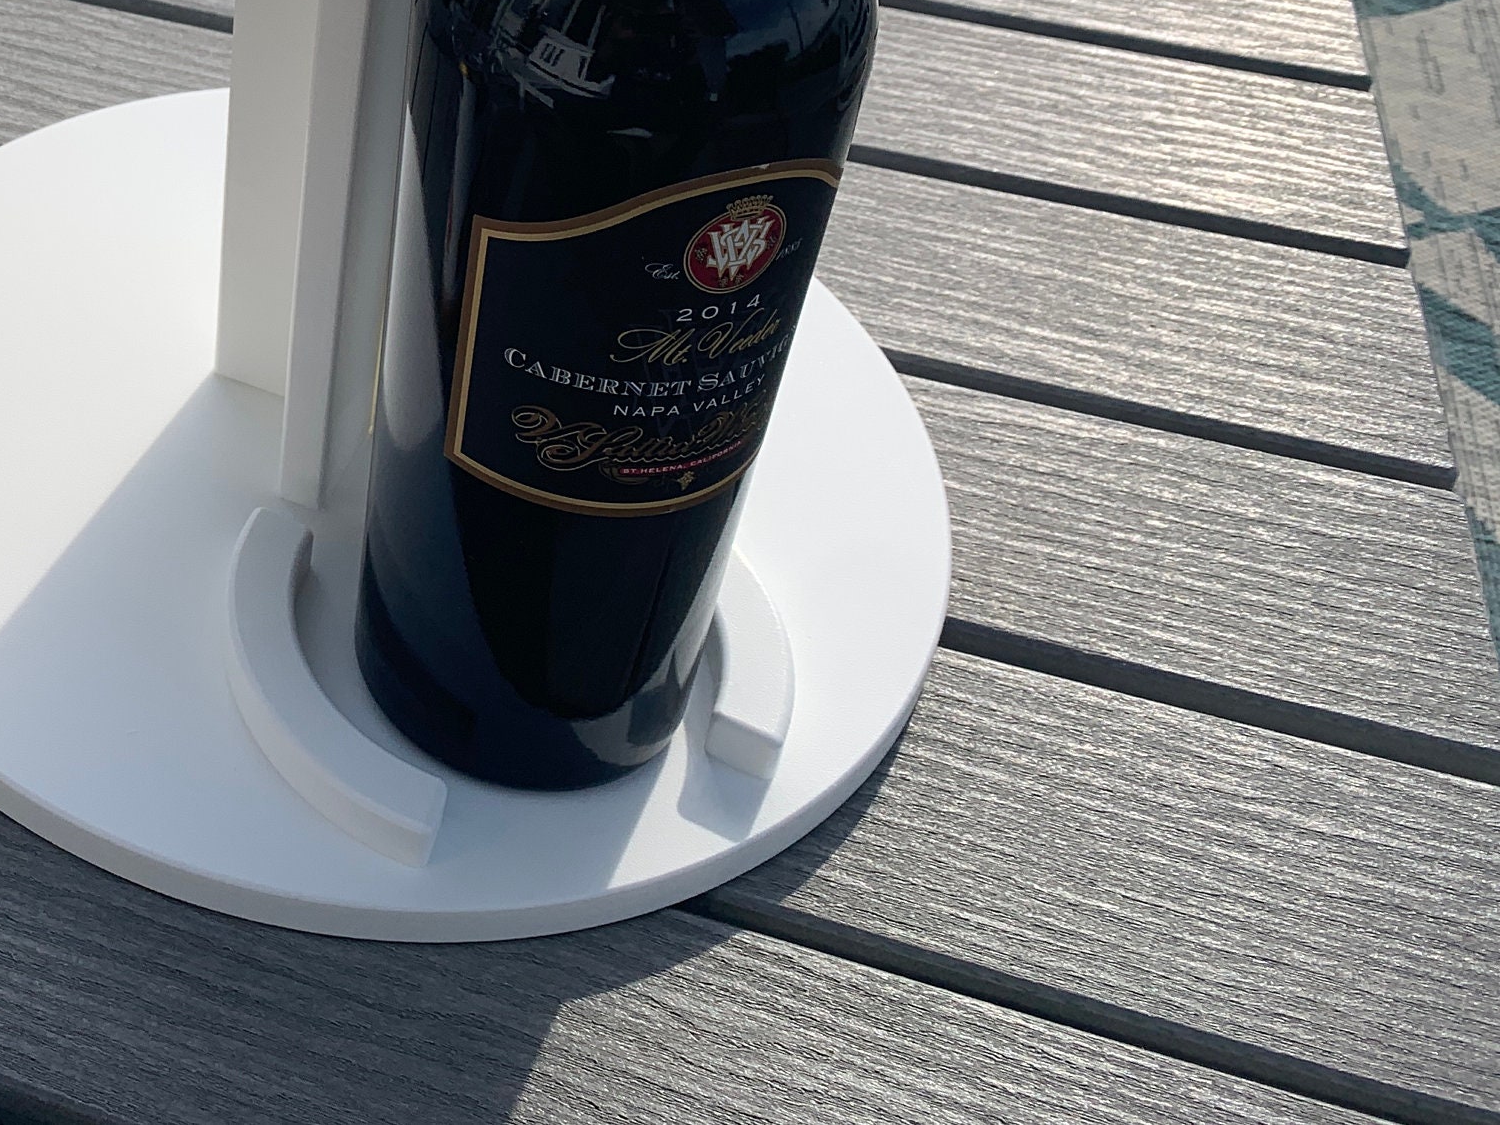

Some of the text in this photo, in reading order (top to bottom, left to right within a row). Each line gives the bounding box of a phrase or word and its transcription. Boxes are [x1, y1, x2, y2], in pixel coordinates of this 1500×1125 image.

[676, 293, 762, 322] 2014
[608, 328, 695, 367] Mt.
[503, 347, 692, 398] CABERNET
[612, 374, 766, 418] NAPA VALLEY
